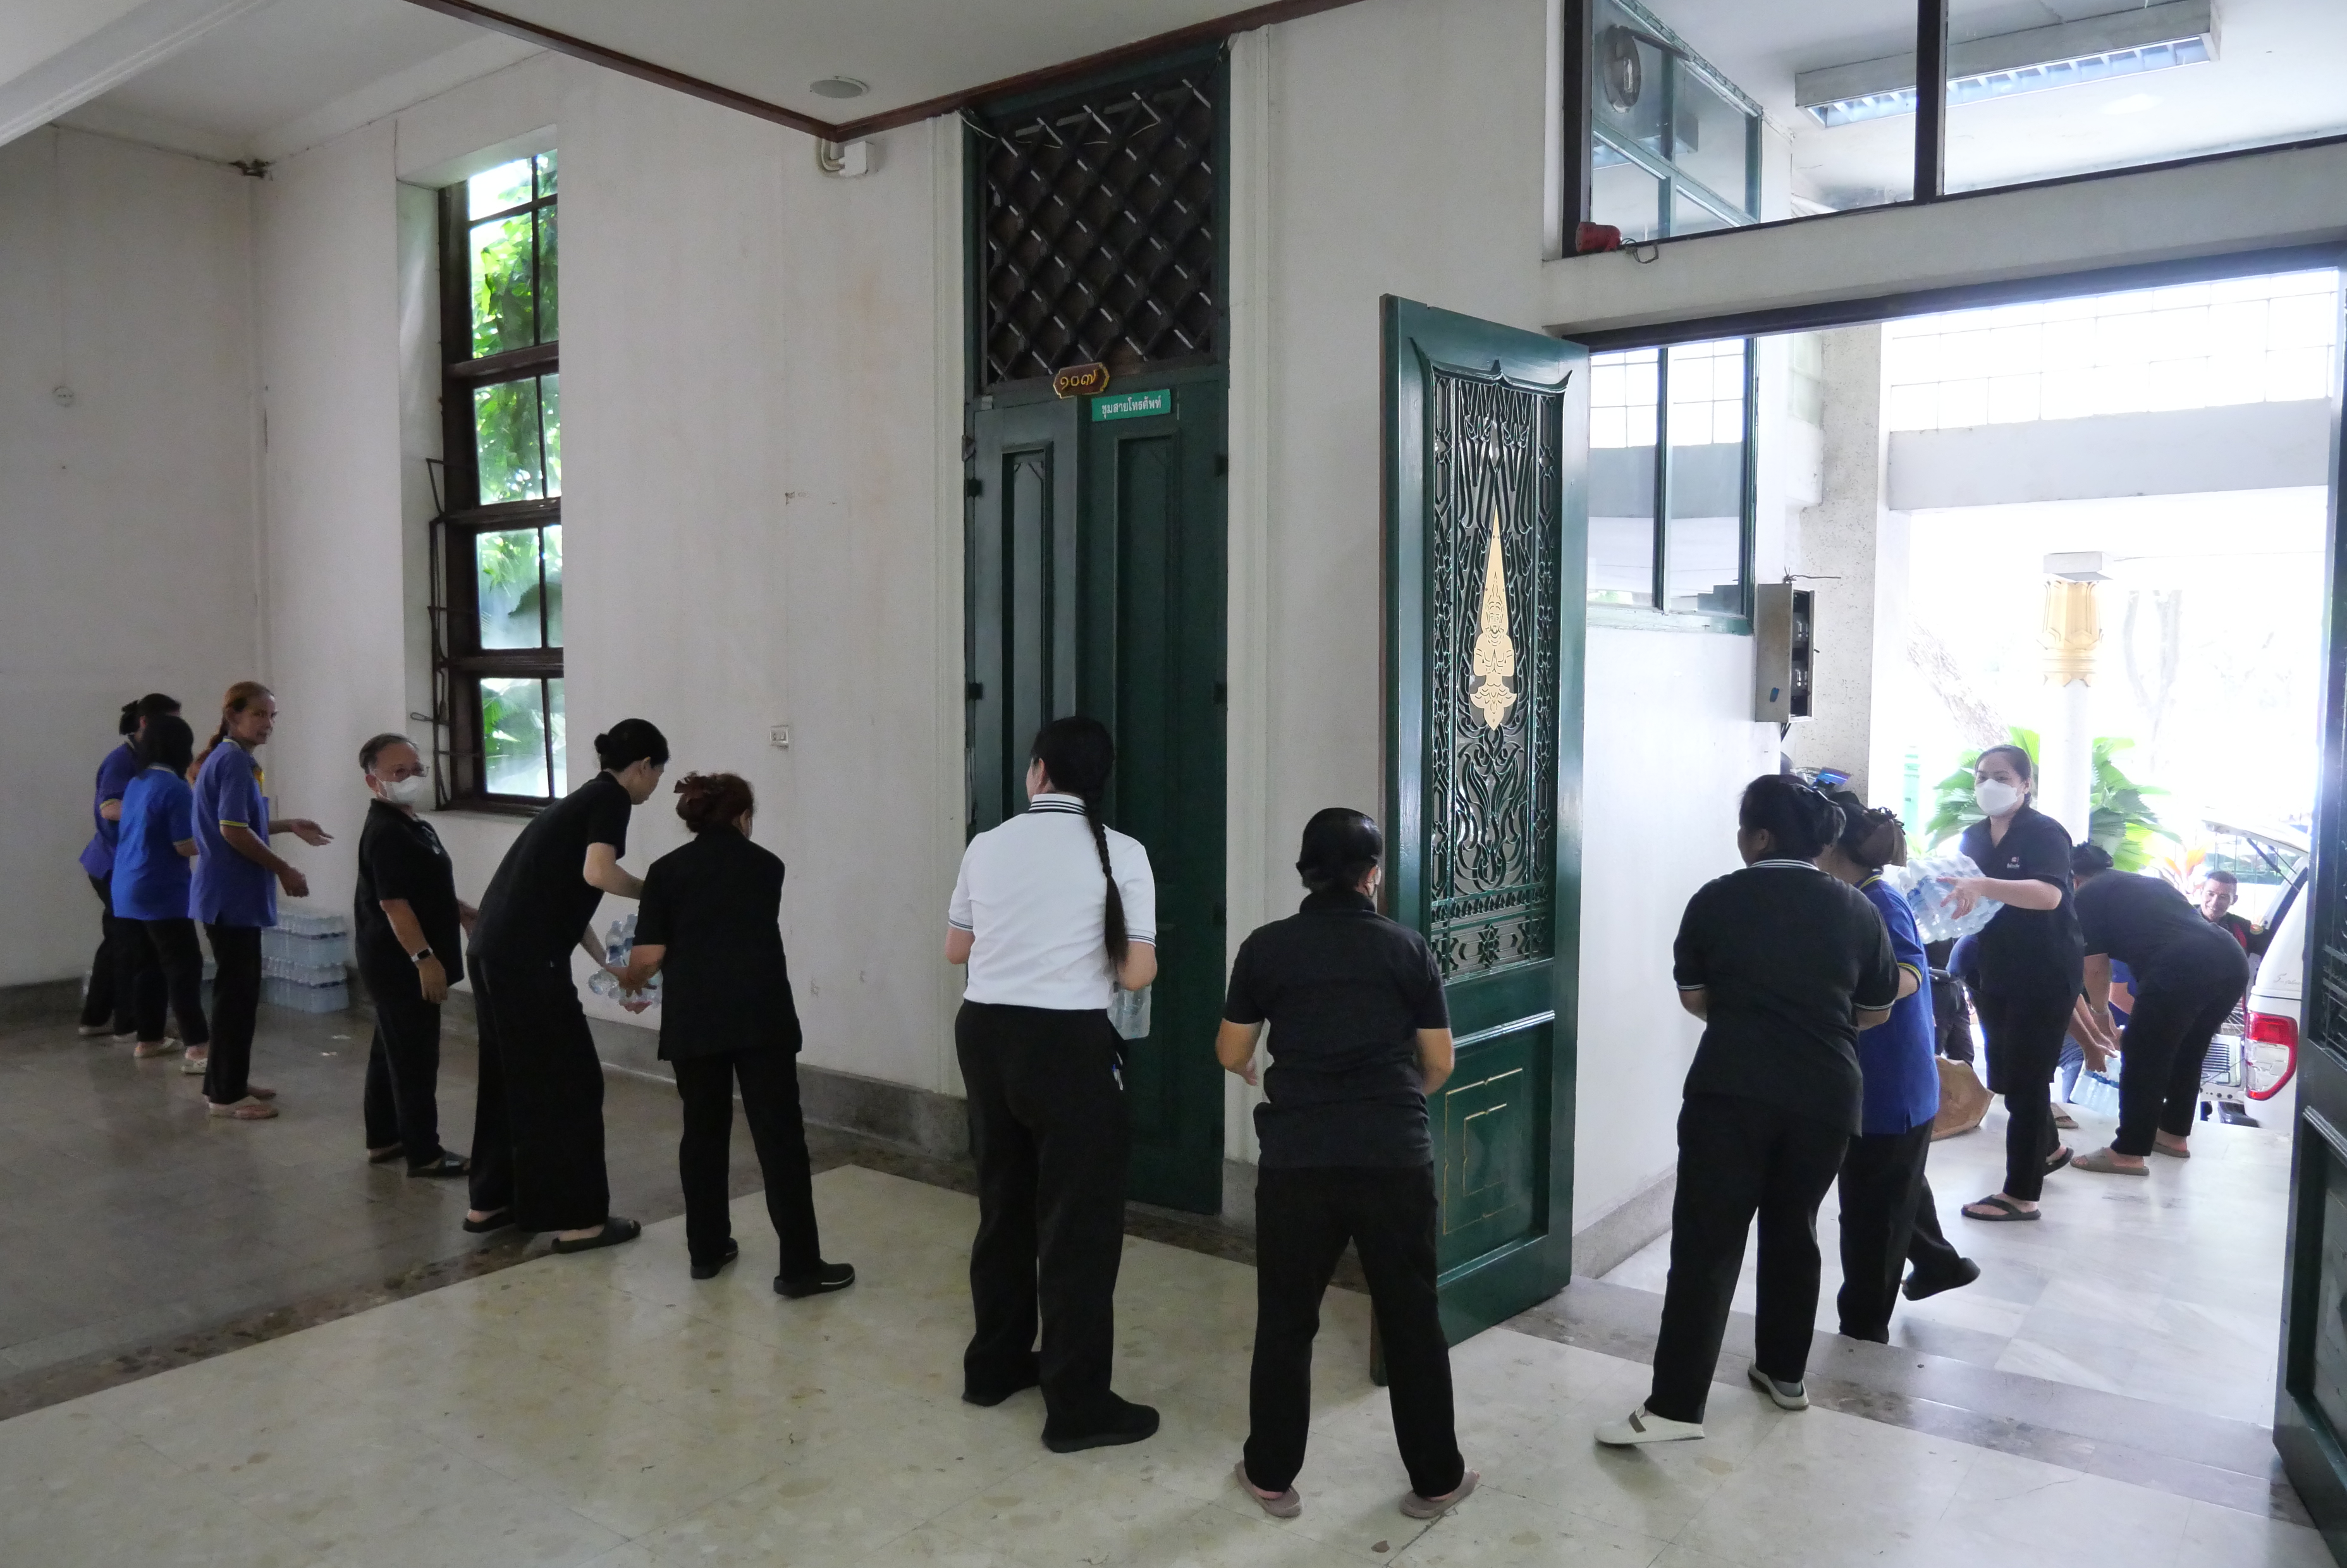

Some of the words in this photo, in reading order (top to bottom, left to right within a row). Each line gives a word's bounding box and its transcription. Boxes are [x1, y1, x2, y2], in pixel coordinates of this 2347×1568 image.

[1060, 369, 1097, 390] ๑๐๗
[1101, 395, 1161, 419] ชุมสายโทรศัพท์
